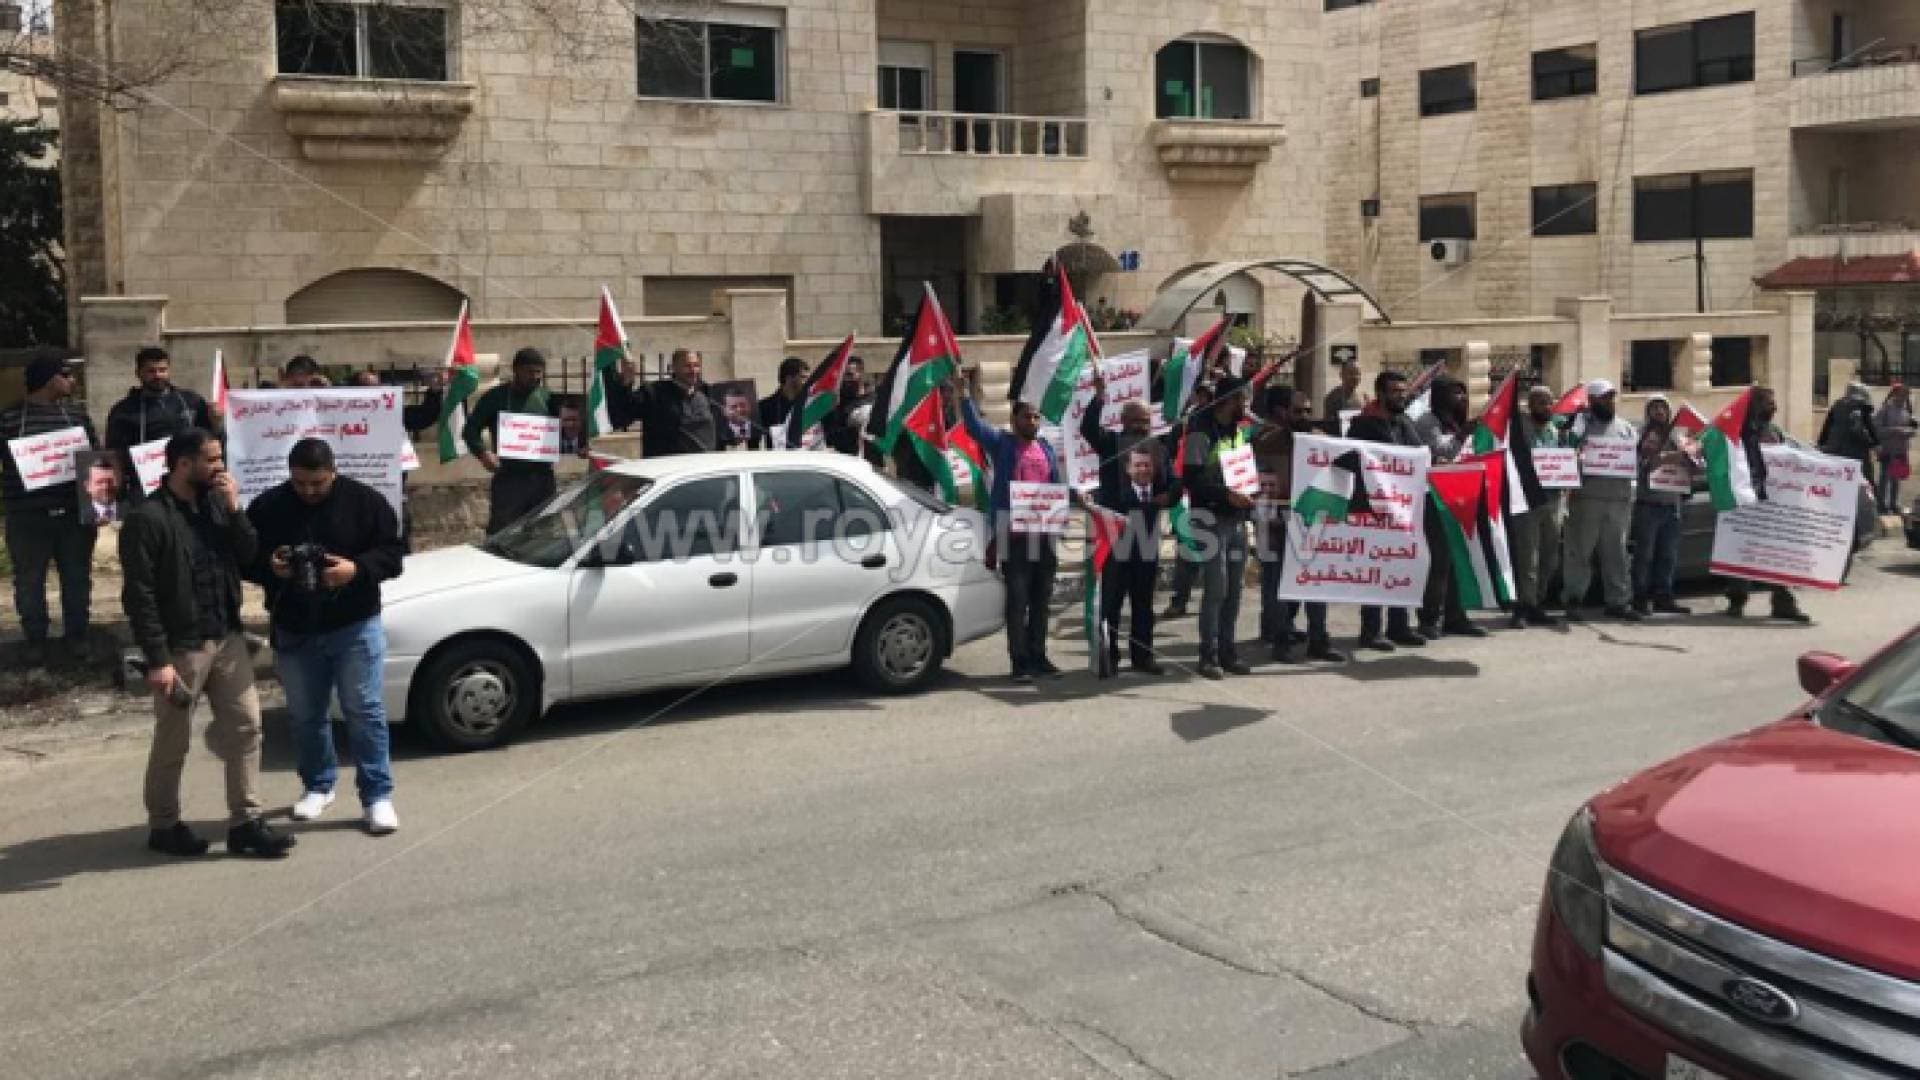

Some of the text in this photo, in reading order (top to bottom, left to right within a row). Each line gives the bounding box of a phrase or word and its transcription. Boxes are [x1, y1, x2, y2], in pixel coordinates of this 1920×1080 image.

[1368, 541, 1417, 562] لحين
[1295, 563, 1416, 589] من التحقيق
